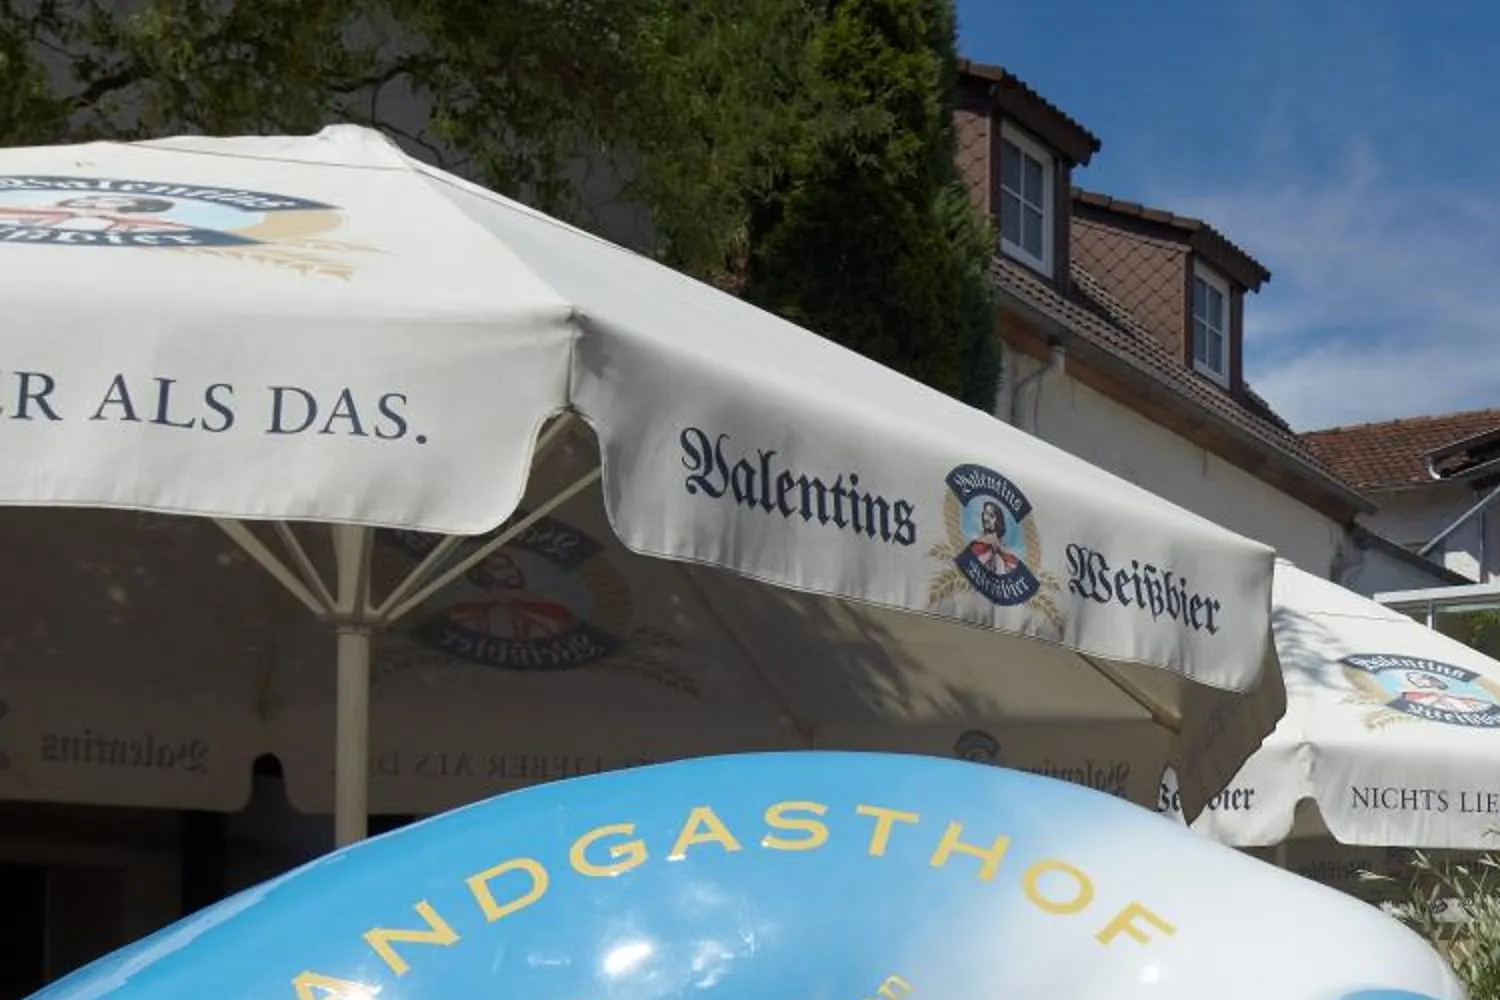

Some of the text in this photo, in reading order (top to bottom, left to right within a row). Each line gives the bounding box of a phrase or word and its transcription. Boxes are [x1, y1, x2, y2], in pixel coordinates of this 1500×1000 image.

[88, 371, 236, 434] ALS
[263, 384, 429, 446] DAS.
[679, 426, 917, 546] Valentins
[1064, 542, 1222, 636] Weißbier
[1350, 786, 1450, 813] NICHTS
